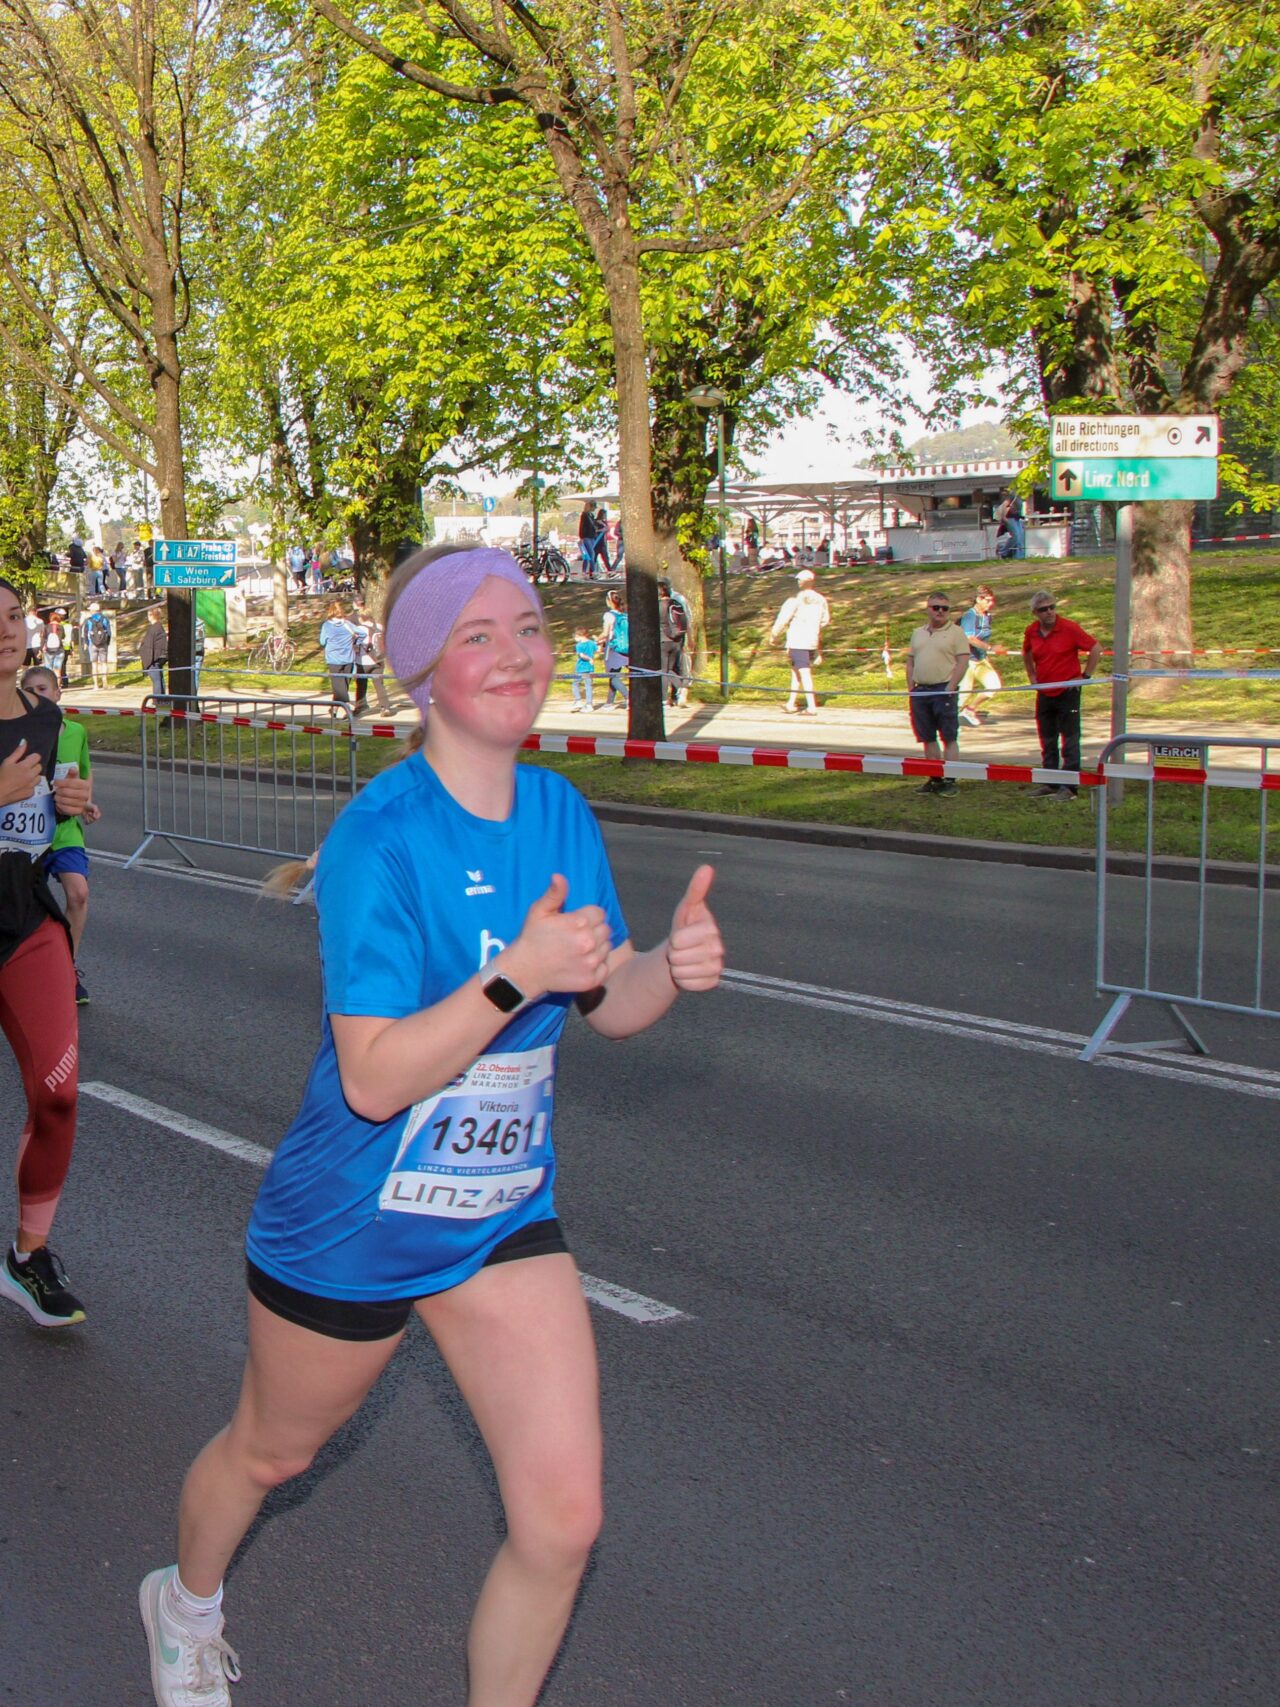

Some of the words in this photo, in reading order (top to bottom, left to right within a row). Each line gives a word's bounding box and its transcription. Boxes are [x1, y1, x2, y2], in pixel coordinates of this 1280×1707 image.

[1055, 422, 1075, 436] Alle
[1079, 422, 1140, 438] Richtungen
[1055, 440, 1068, 452] all
[1070, 440, 1119, 452] directions
[1085, 470, 1113, 488] Linz
[187, 546, 199, 558] A7
[185, 567, 209, 575] Wien
[177, 576, 217, 586] Salzburg
[1, 812, 45, 834] 8310
[44, 1044, 77, 1093] PUMA
[471, 1080, 519, 1088] MARATHON
[479, 1100, 519, 1113] Viktoria
[431, 1115, 535, 1156] 13461
[391, 1181, 484, 1208] LINZ
[486, 1185, 530, 1207] AG
